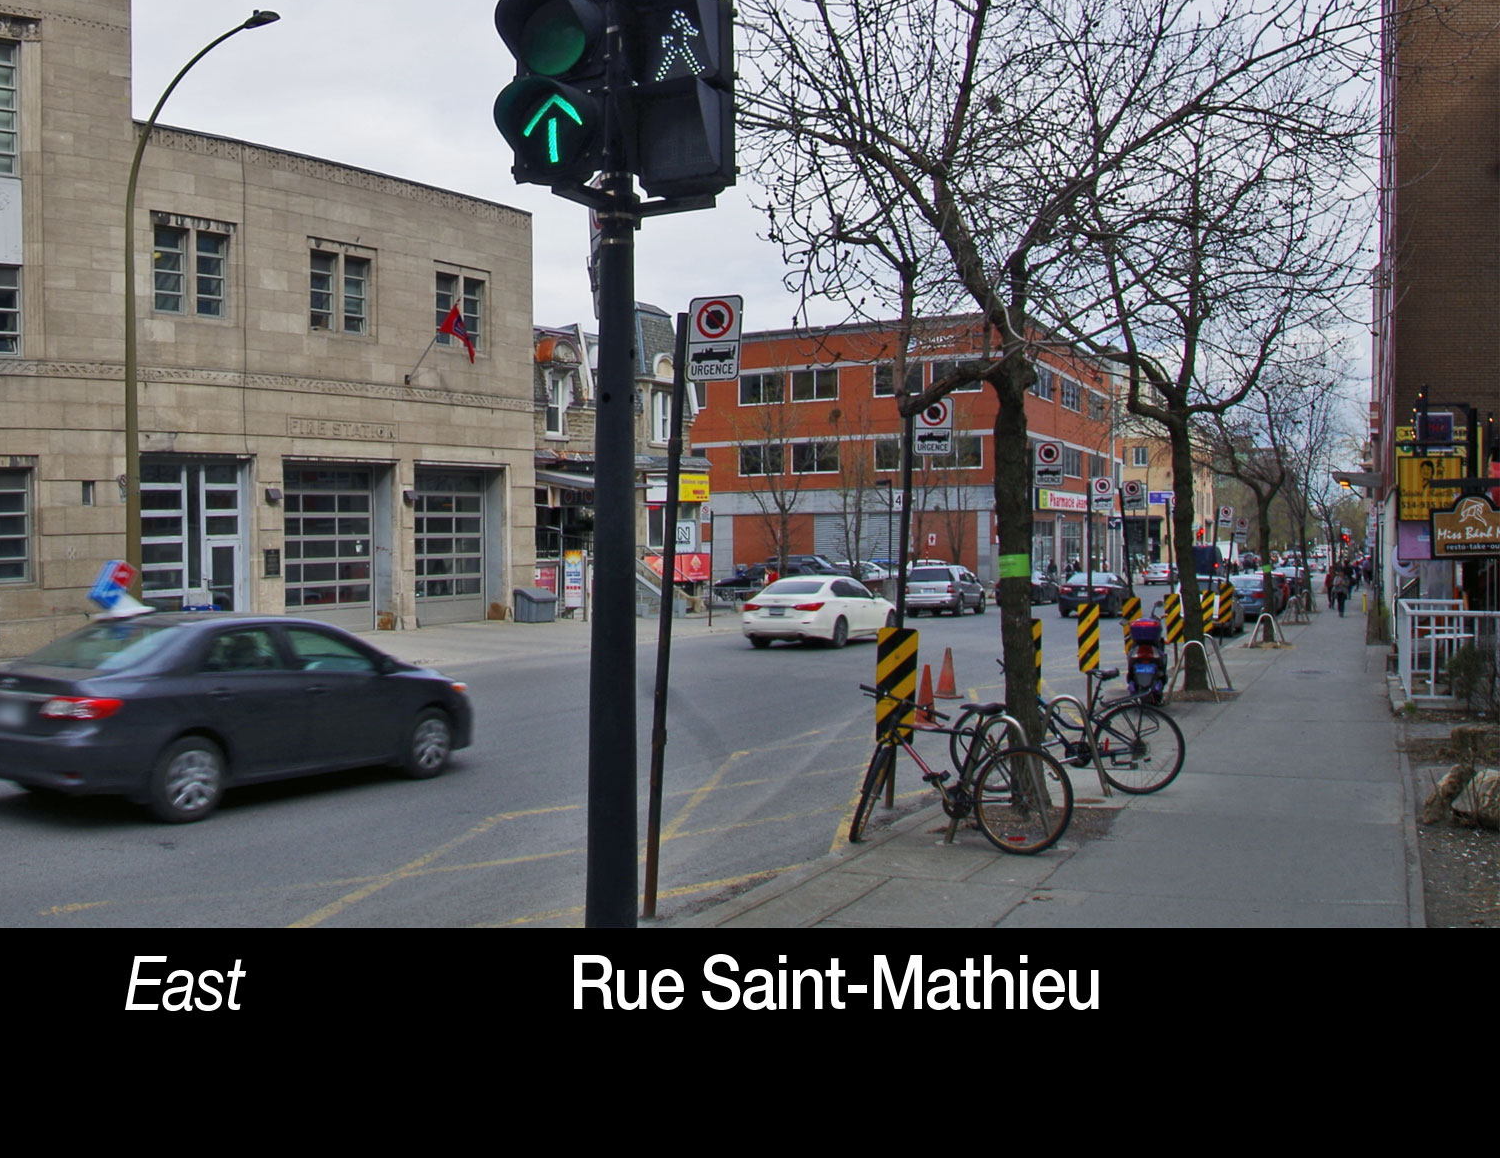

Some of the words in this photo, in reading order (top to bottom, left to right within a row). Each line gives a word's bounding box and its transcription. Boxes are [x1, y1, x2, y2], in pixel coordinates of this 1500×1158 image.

[691, 363, 734, 376] URGENCE
[289, 420, 327, 436] FIRE
[332, 423, 396, 439] STATION
[917, 442, 949, 451] URGENCE
[1049, 493, 1076, 507] Pharmacie
[1437, 528, 1462, 540] Miss
